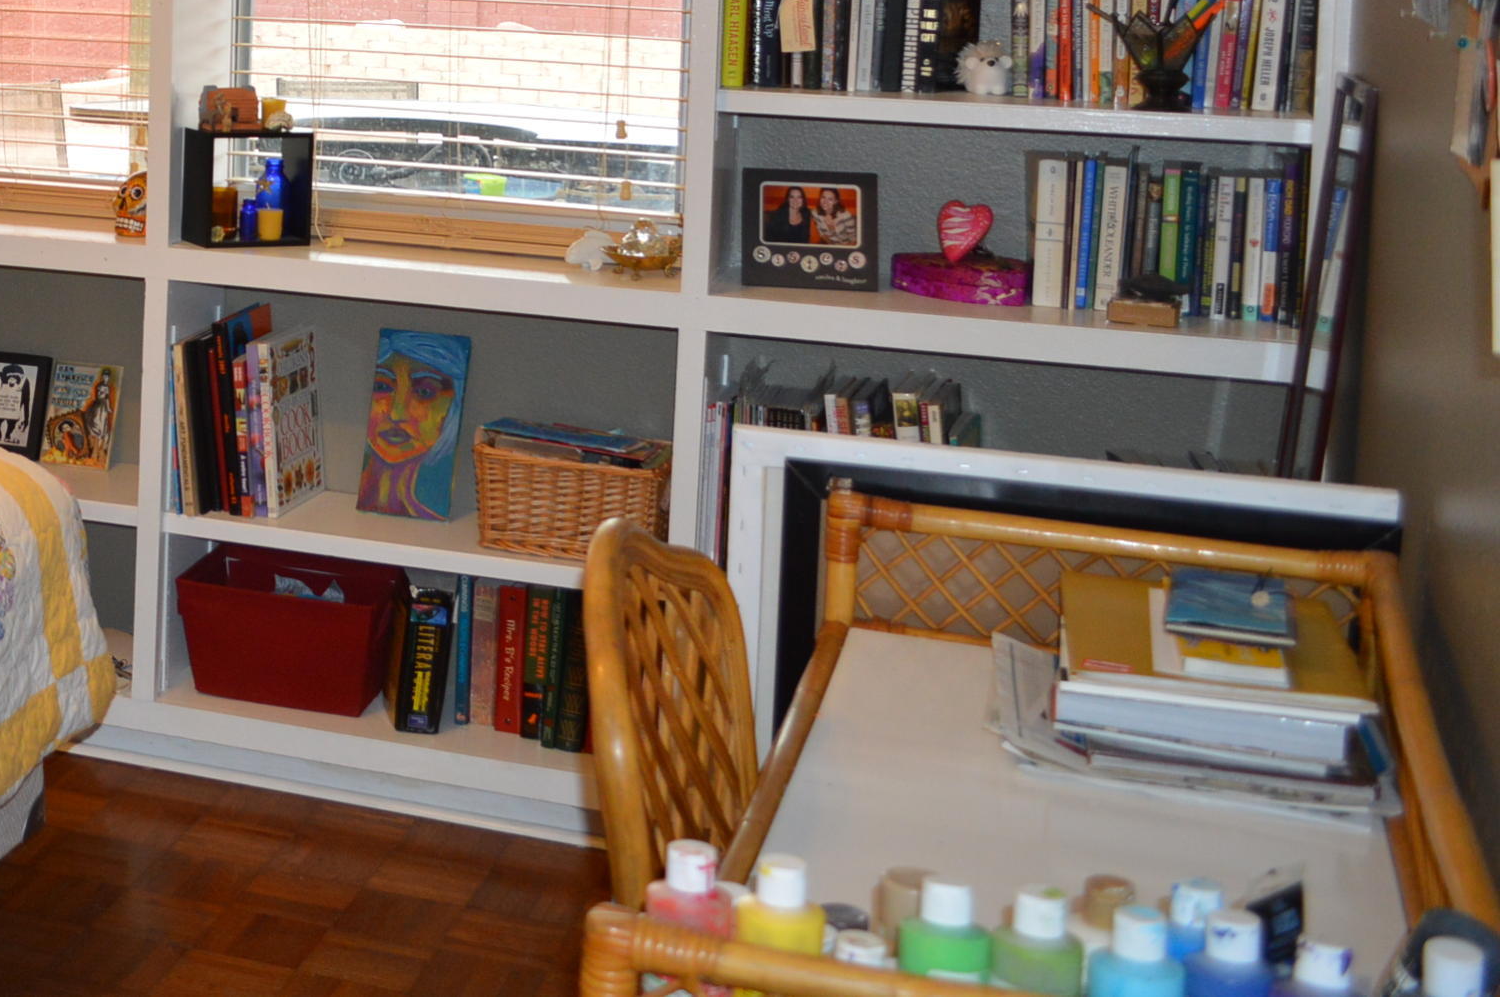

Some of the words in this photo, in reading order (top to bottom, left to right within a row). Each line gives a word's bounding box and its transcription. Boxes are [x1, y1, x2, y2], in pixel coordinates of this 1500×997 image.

[924, 9, 937, 19] THE
[728, 21, 740, 66] HIAASEN
[763, 25, 775, 38] Up
[1264, 27, 1275, 56] JOSEPH
[1260, 59, 1274, 86] HELLER
[1108, 187, 1119, 217] WHITE
[1285, 200, 1293, 216] DAD
[1103, 228, 1115, 277] OLEANDER
[280, 404, 311, 435] COOK
[282, 428, 312, 461] BOOK
[180, 437, 190, 491] FUNDAMENTALS
[461, 575, 469, 612] CUMMINGS
[532, 598, 540, 607] IN
[530, 610, 538, 624] THE
[541, 599, 549, 618] HOW
[506, 619, 516, 643] Mrs.
[540, 622, 547, 631] TO
[504, 647, 515, 663] B's
[529, 628, 538, 657] WOODS
[538, 635, 547, 653] STAY
[536, 656, 546, 679] ALIVE
[501, 667, 514, 701] Recipes
